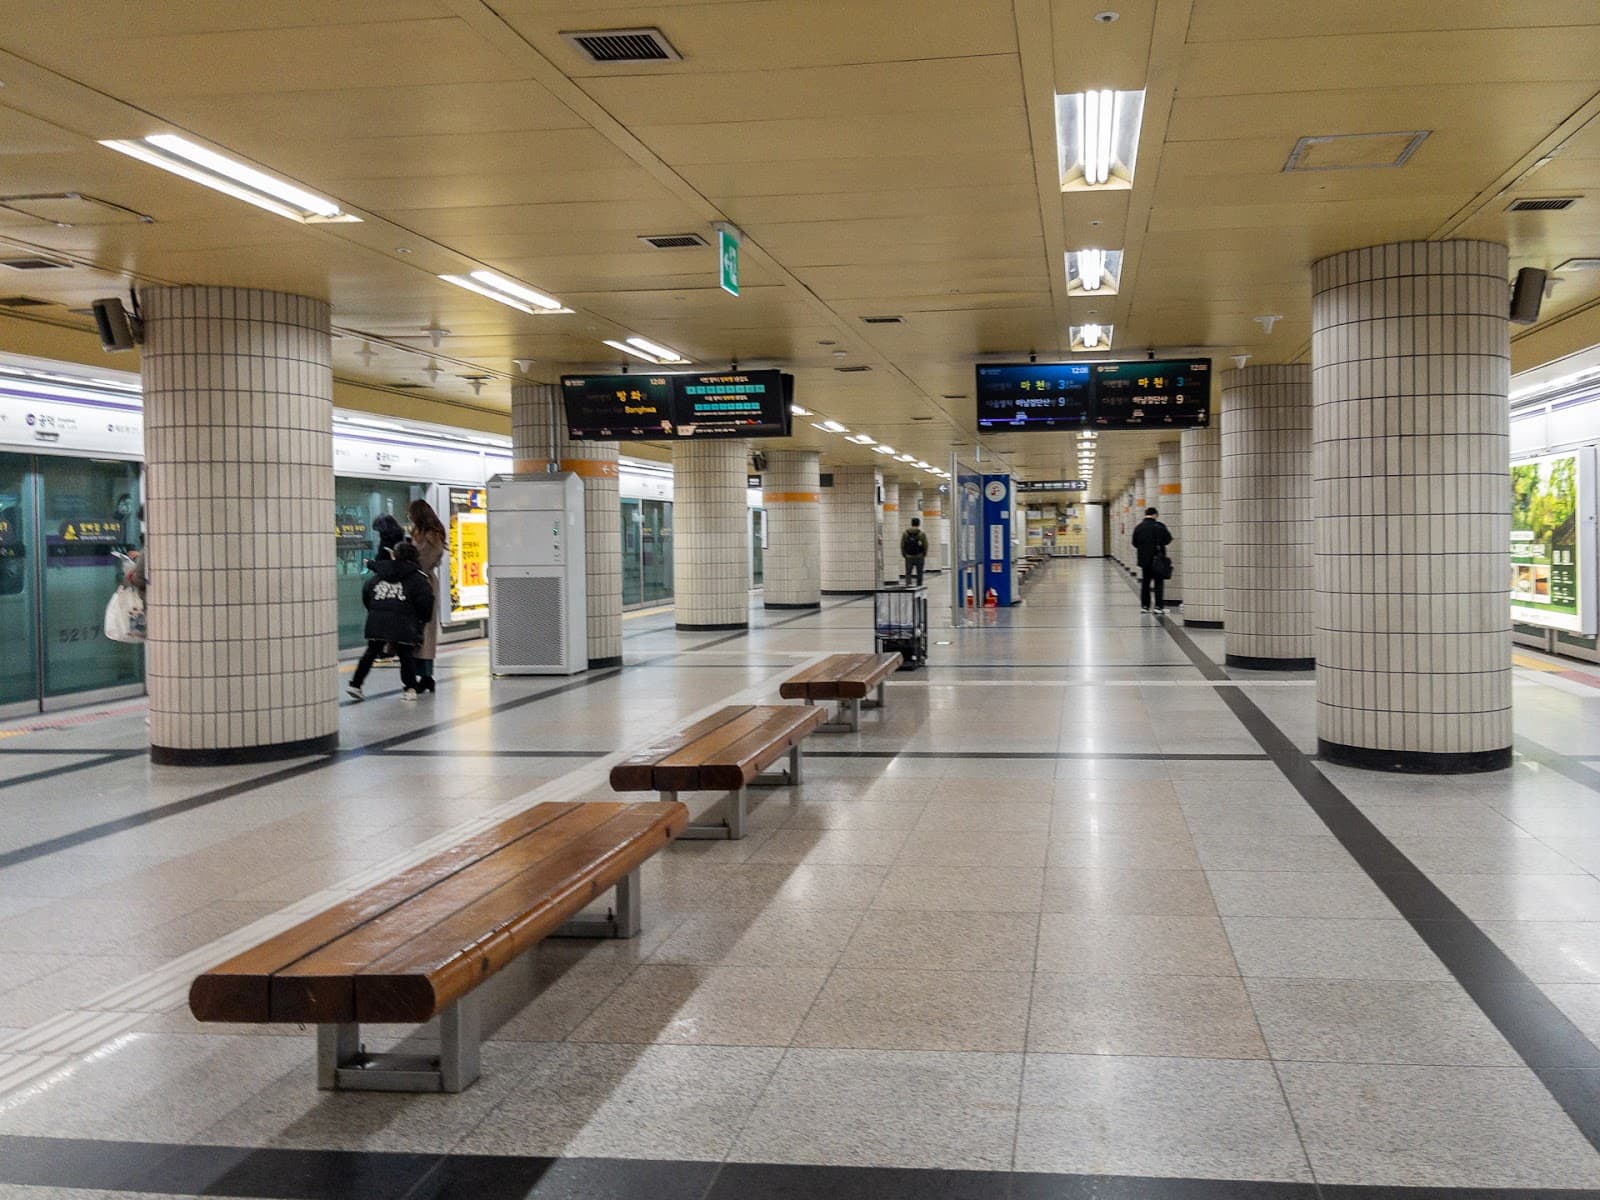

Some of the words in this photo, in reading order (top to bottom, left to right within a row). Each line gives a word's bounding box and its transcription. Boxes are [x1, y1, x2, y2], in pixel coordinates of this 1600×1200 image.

[1057, 379, 1065, 390] 3
[1176, 376, 1184, 387] 3
[1057, 396, 1065, 407] 9
[1175, 394, 1184, 405] 9
